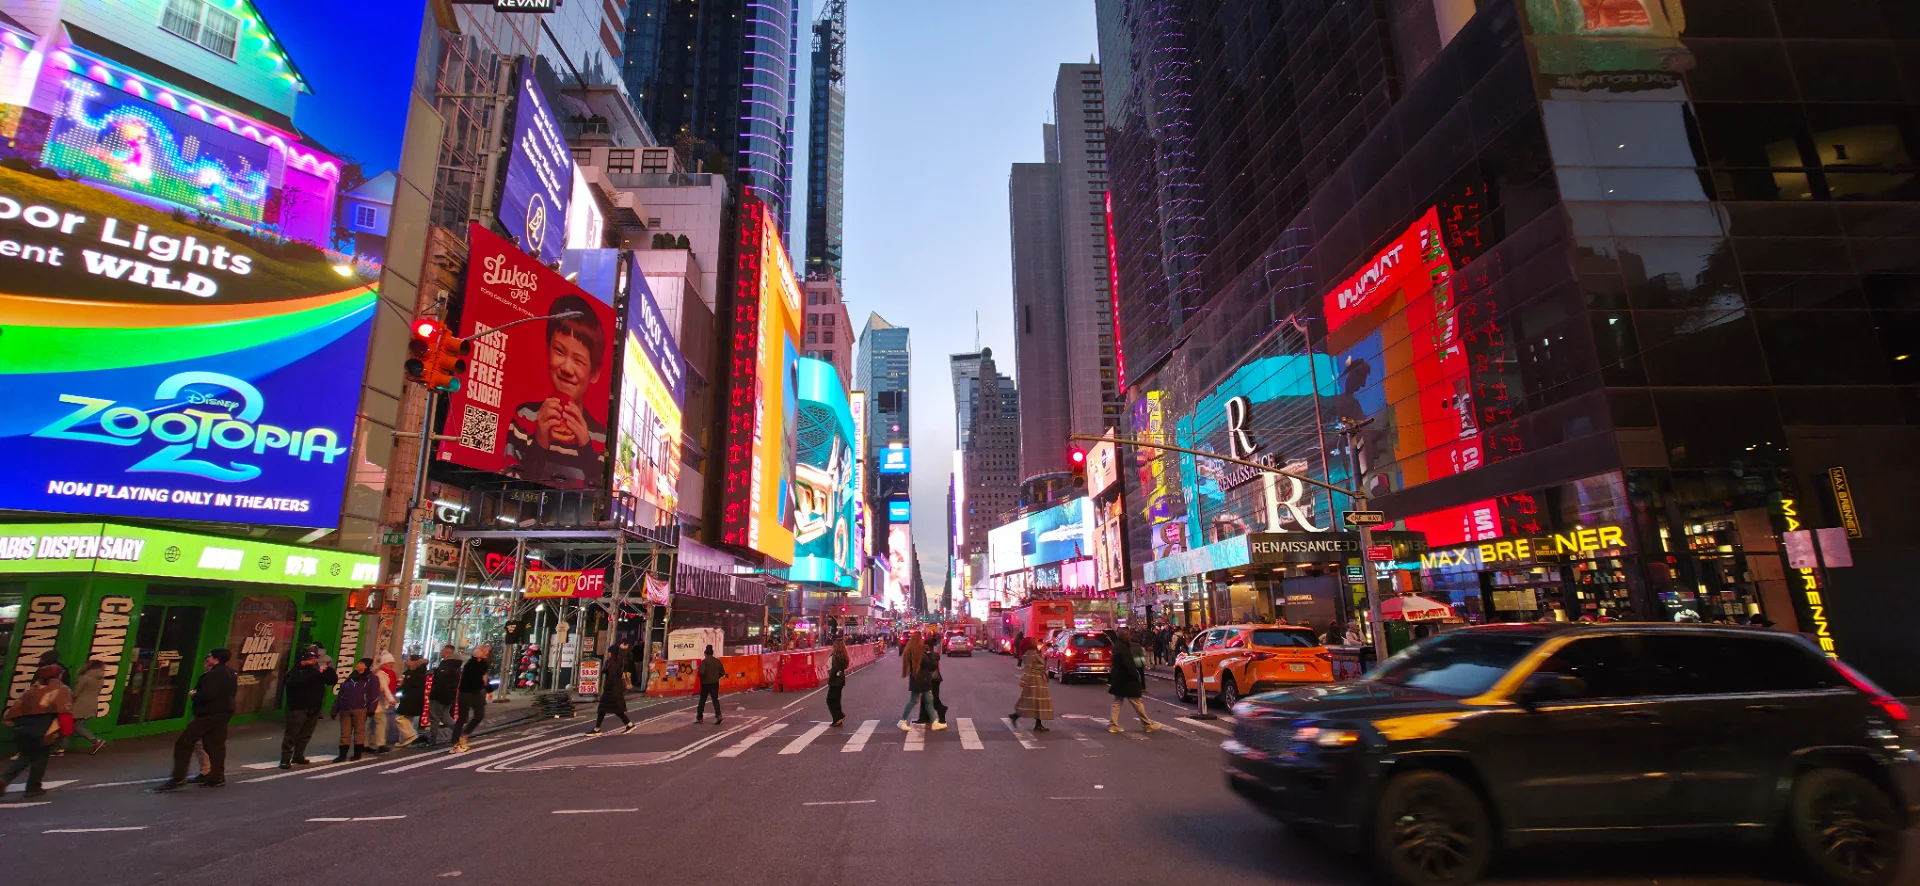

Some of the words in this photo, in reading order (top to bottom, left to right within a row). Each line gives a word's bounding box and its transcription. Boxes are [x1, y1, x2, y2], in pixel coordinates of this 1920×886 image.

[101, 217, 252, 275] Lights
[82, 249, 218, 298] WILD
[475, 321, 509, 351] FIRST
[473, 341, 506, 370] TIME?
[469, 360, 504, 389] FREE
[467, 379, 502, 408] SLIDER!
[30, 393, 347, 464] ZOOTOPIA
[1224, 396, 1258, 463] R
[751, 455, 762, 513] COME
[1832, 470, 1845, 490] MAX
[48, 480, 92, 496] NOW
[95, 483, 168, 502] PLAYING
[172, 489, 214, 506] ONLY
[215, 492, 233, 507] IN
[234, 494, 309, 512] THEATERS
[1258, 472, 1329, 533] R
[1781, 499, 1800, 532] MA
[1838, 491, 1858, 536] BRENNER
[36, 535, 145, 562] DISPENSARY
[1252, 540, 1343, 553] RENAISSANCE
[1420, 547, 1470, 569] MAX
[1479, 525, 1627, 563] BRENER
[577, 574, 604, 591] OFF
[254, 622, 273, 637] The
[241, 636, 275, 654] DAILY
[242, 652, 280, 671] GREEN
